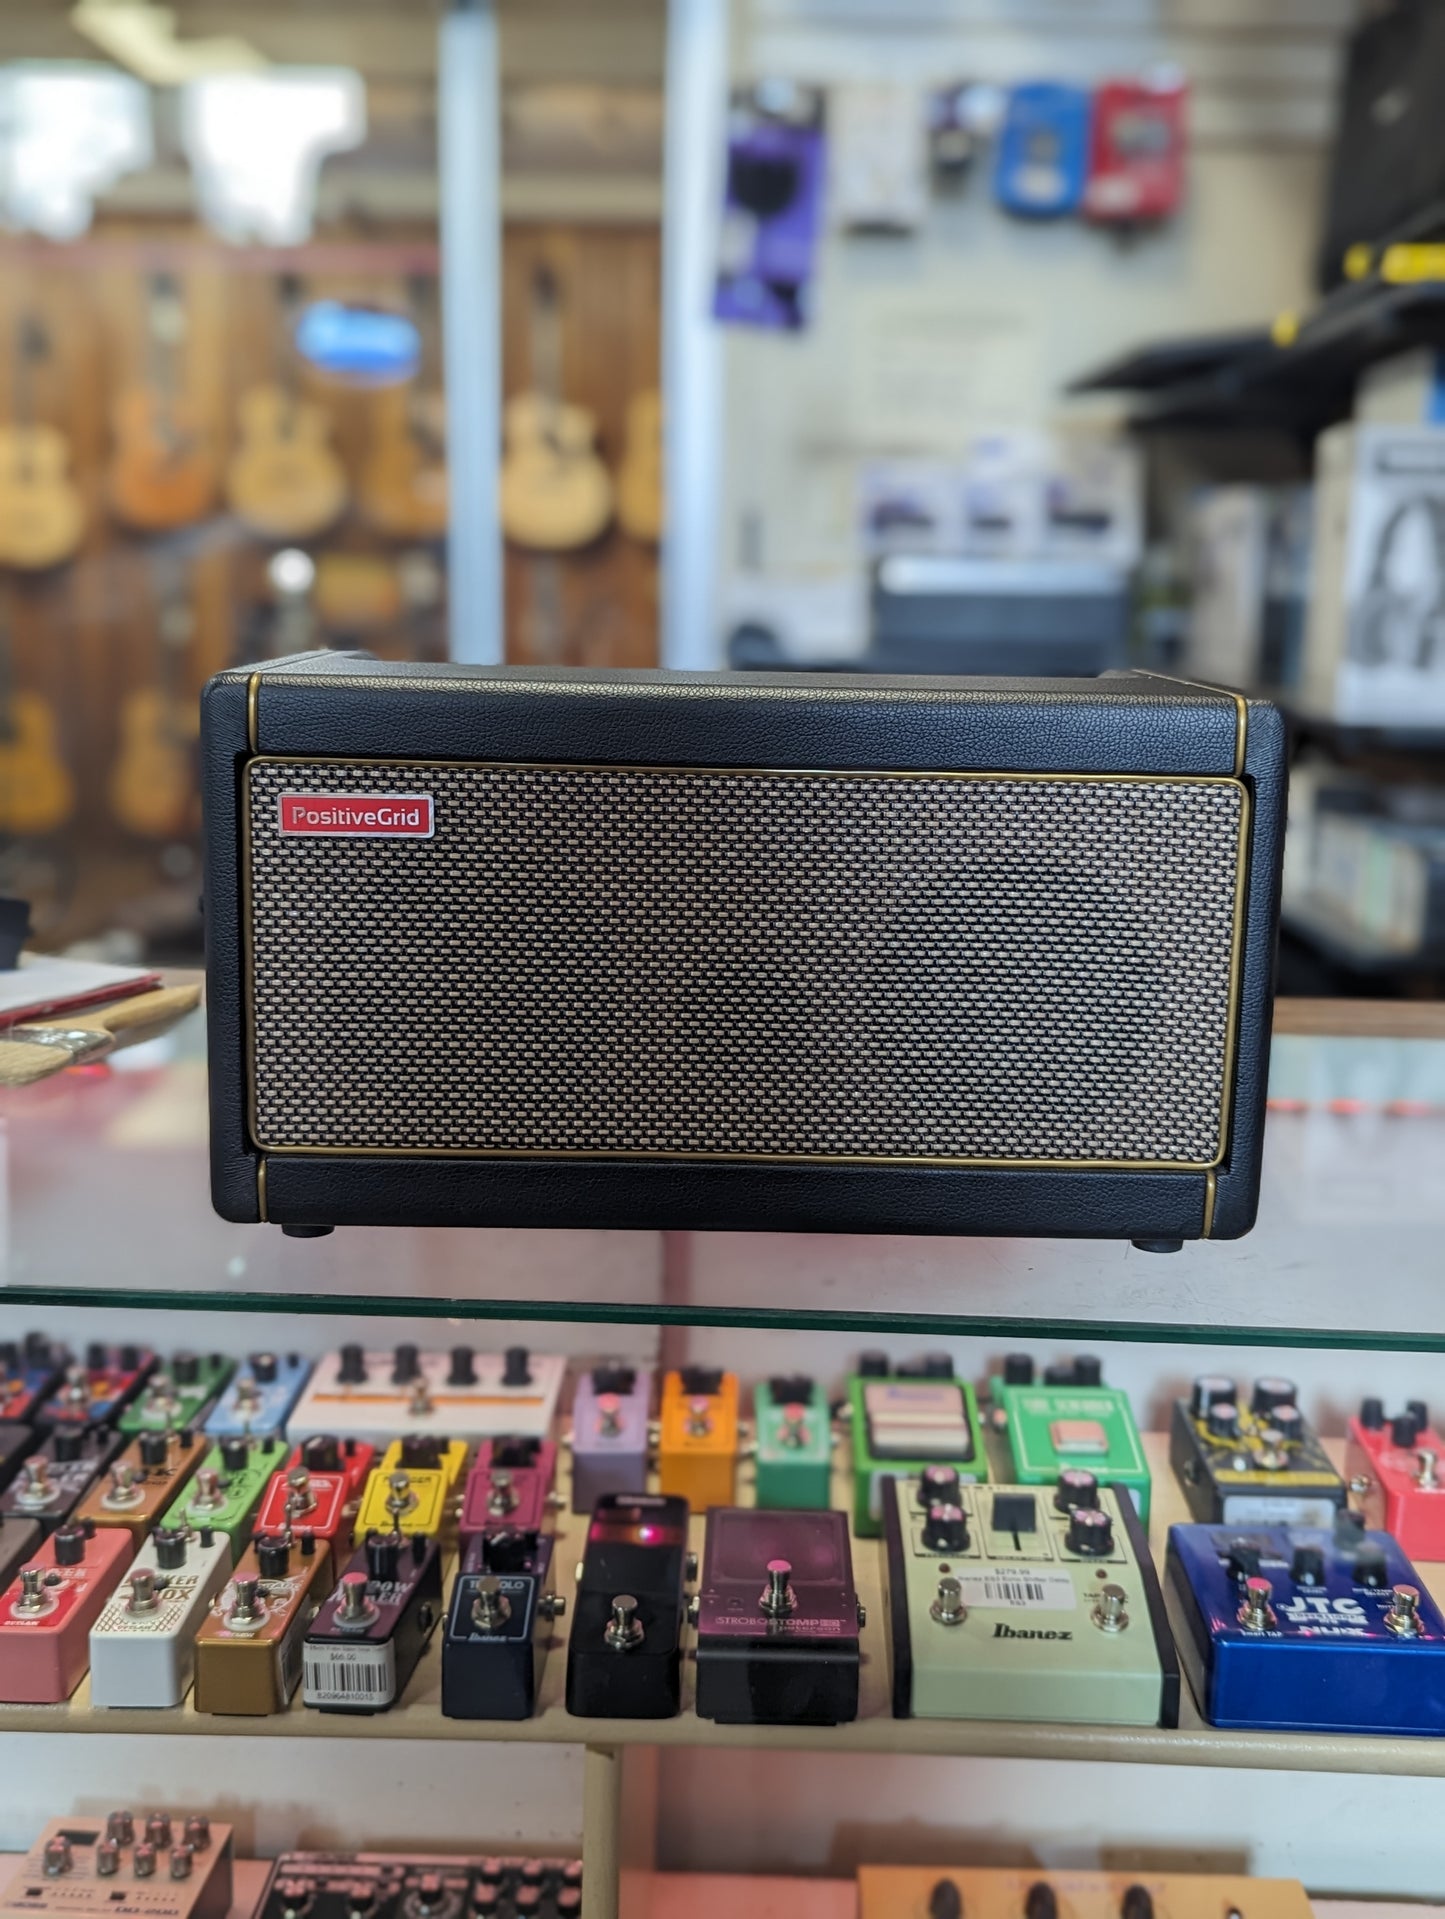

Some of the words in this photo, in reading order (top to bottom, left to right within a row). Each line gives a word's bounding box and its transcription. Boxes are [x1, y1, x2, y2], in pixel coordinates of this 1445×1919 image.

[291, 806, 420, 826] PositiveGrid
[1284, 1596, 1366, 1615] JTC
[992, 1622, 1073, 1641] Ibanez
